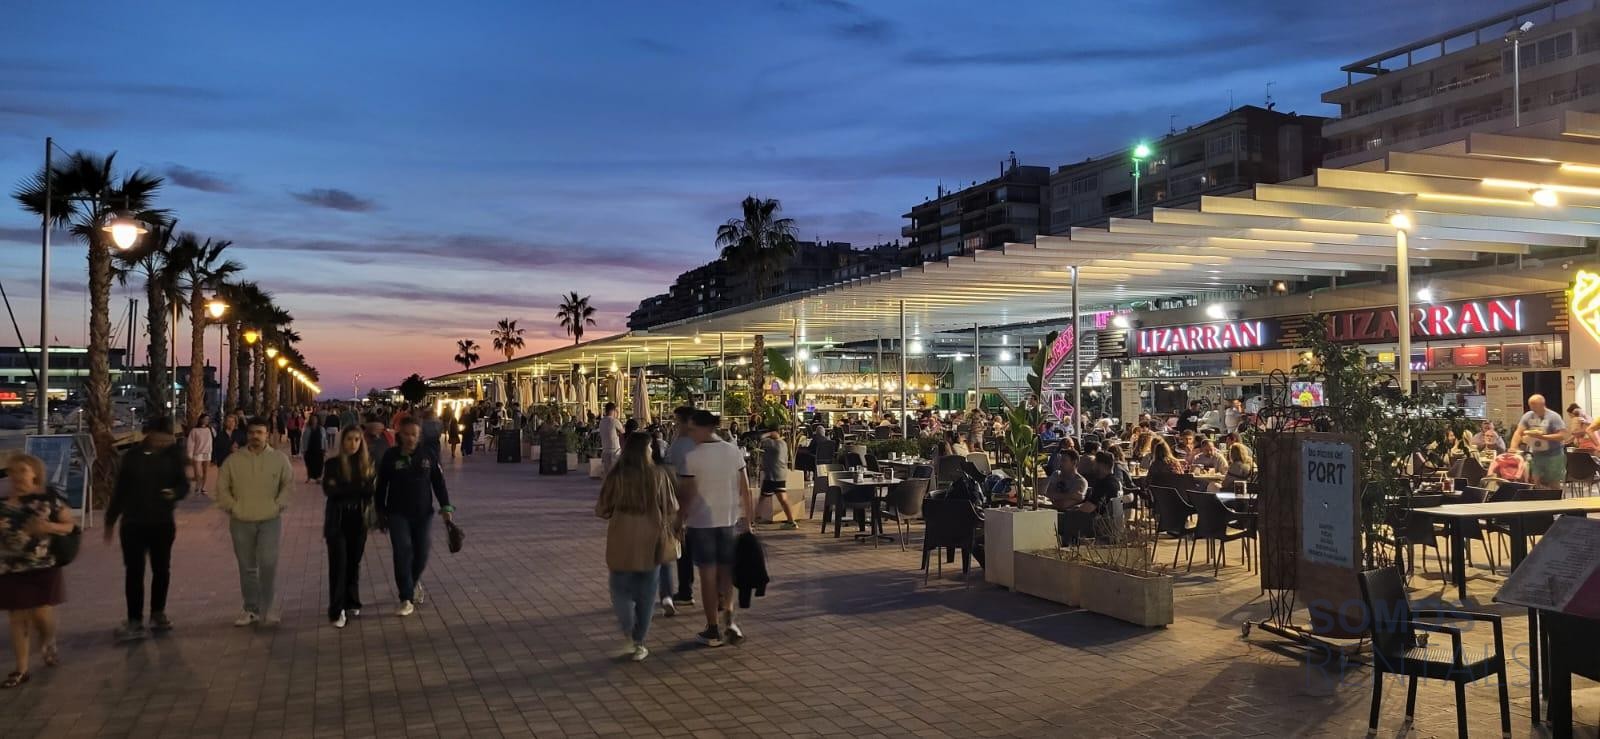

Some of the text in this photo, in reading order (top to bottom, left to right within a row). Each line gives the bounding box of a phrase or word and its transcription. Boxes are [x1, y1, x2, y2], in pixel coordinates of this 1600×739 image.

[1326, 299, 1521, 341] LIZARRAN
[1136, 321, 1263, 353] LIZARRAN
[1308, 460, 1346, 485] PORT
